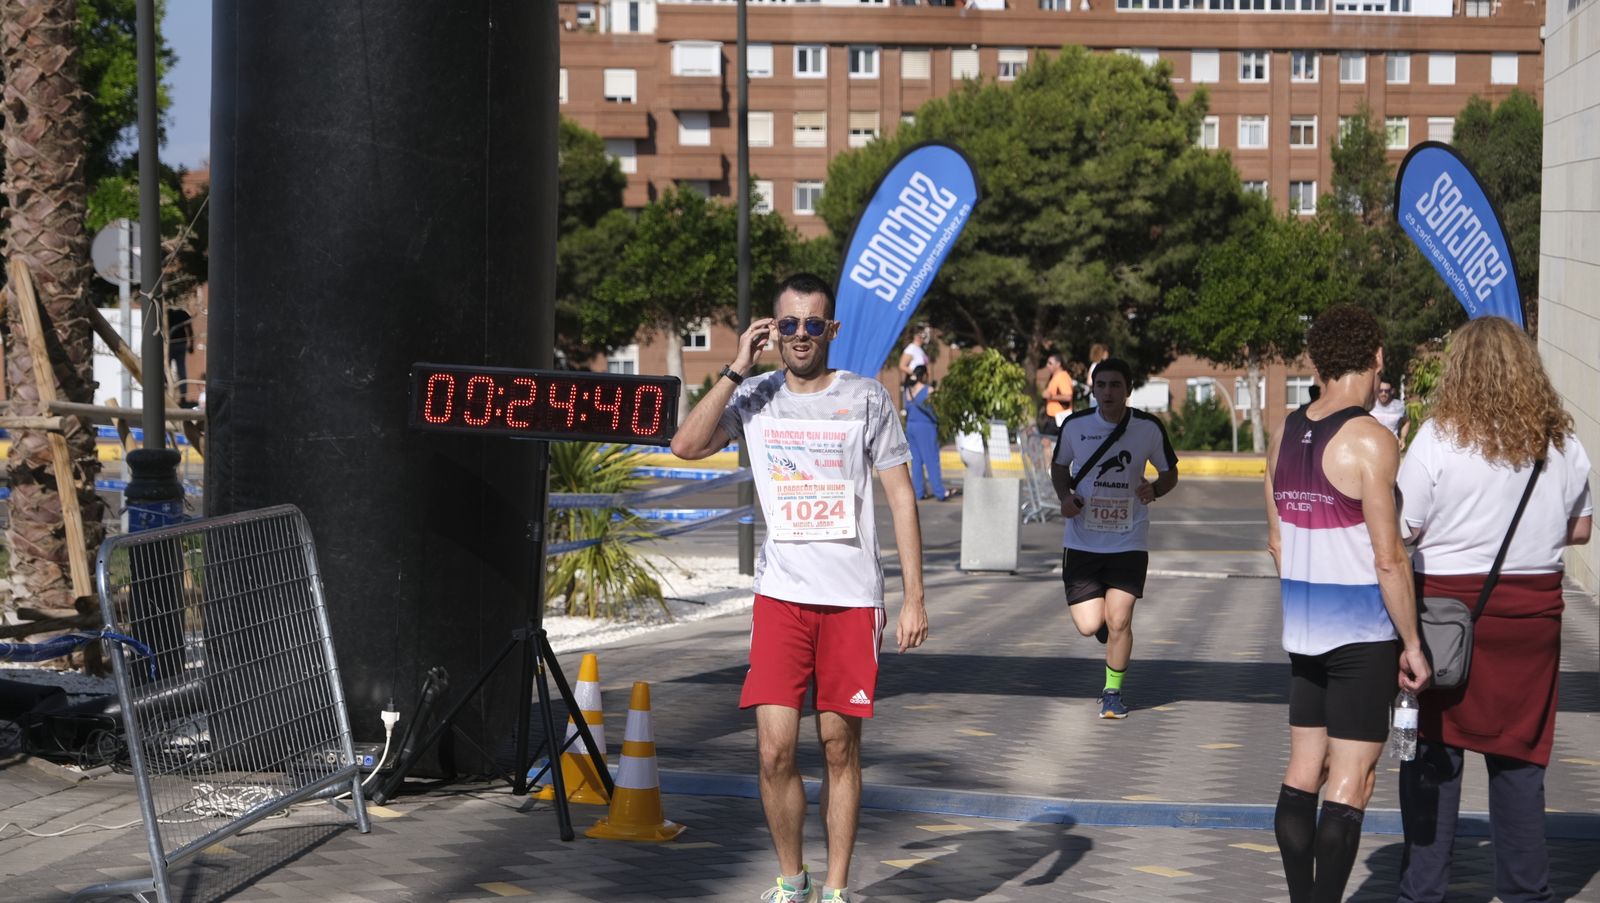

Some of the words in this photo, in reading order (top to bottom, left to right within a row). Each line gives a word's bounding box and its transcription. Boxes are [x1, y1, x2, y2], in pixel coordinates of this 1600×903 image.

[897, 203, 971, 312] centrohogarsanchez.es
[780, 499, 846, 521] 1024
[1091, 507, 1129, 520] 1043
